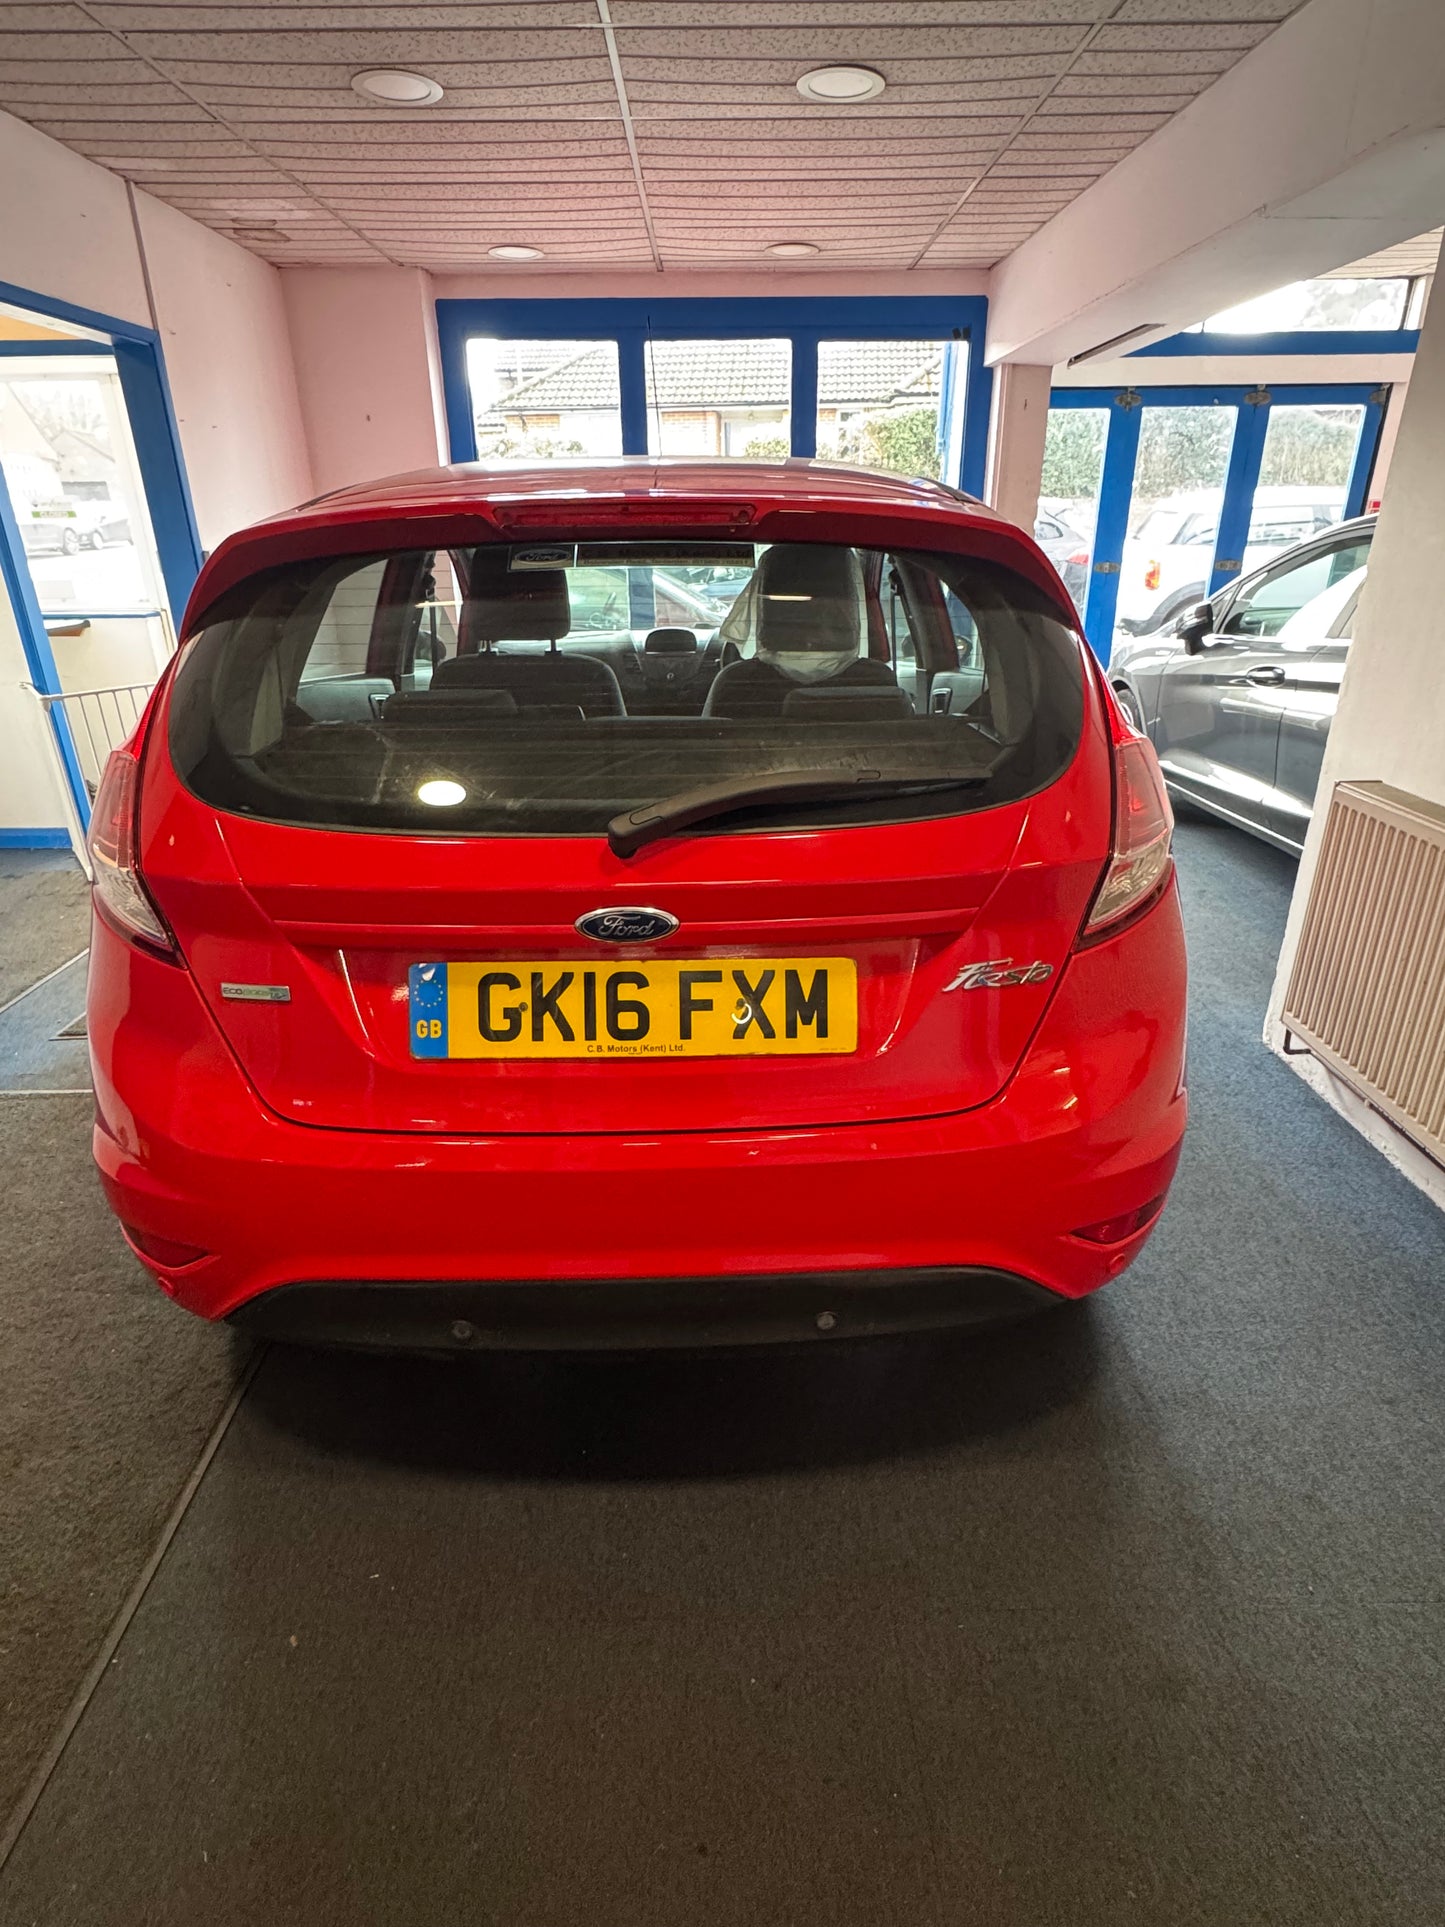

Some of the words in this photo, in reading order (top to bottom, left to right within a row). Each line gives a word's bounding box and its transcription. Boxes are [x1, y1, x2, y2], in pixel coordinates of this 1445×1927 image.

[599, 914, 656, 936] Ford
[942, 957, 1054, 992] Fiesta
[477, 970, 650, 1042] GK16
[678, 969, 829, 1041] FXM
[416, 1019, 442, 1038] GB
[607, 1044, 637, 1053] Motors
[640, 1044, 666, 1053] (Kent)
